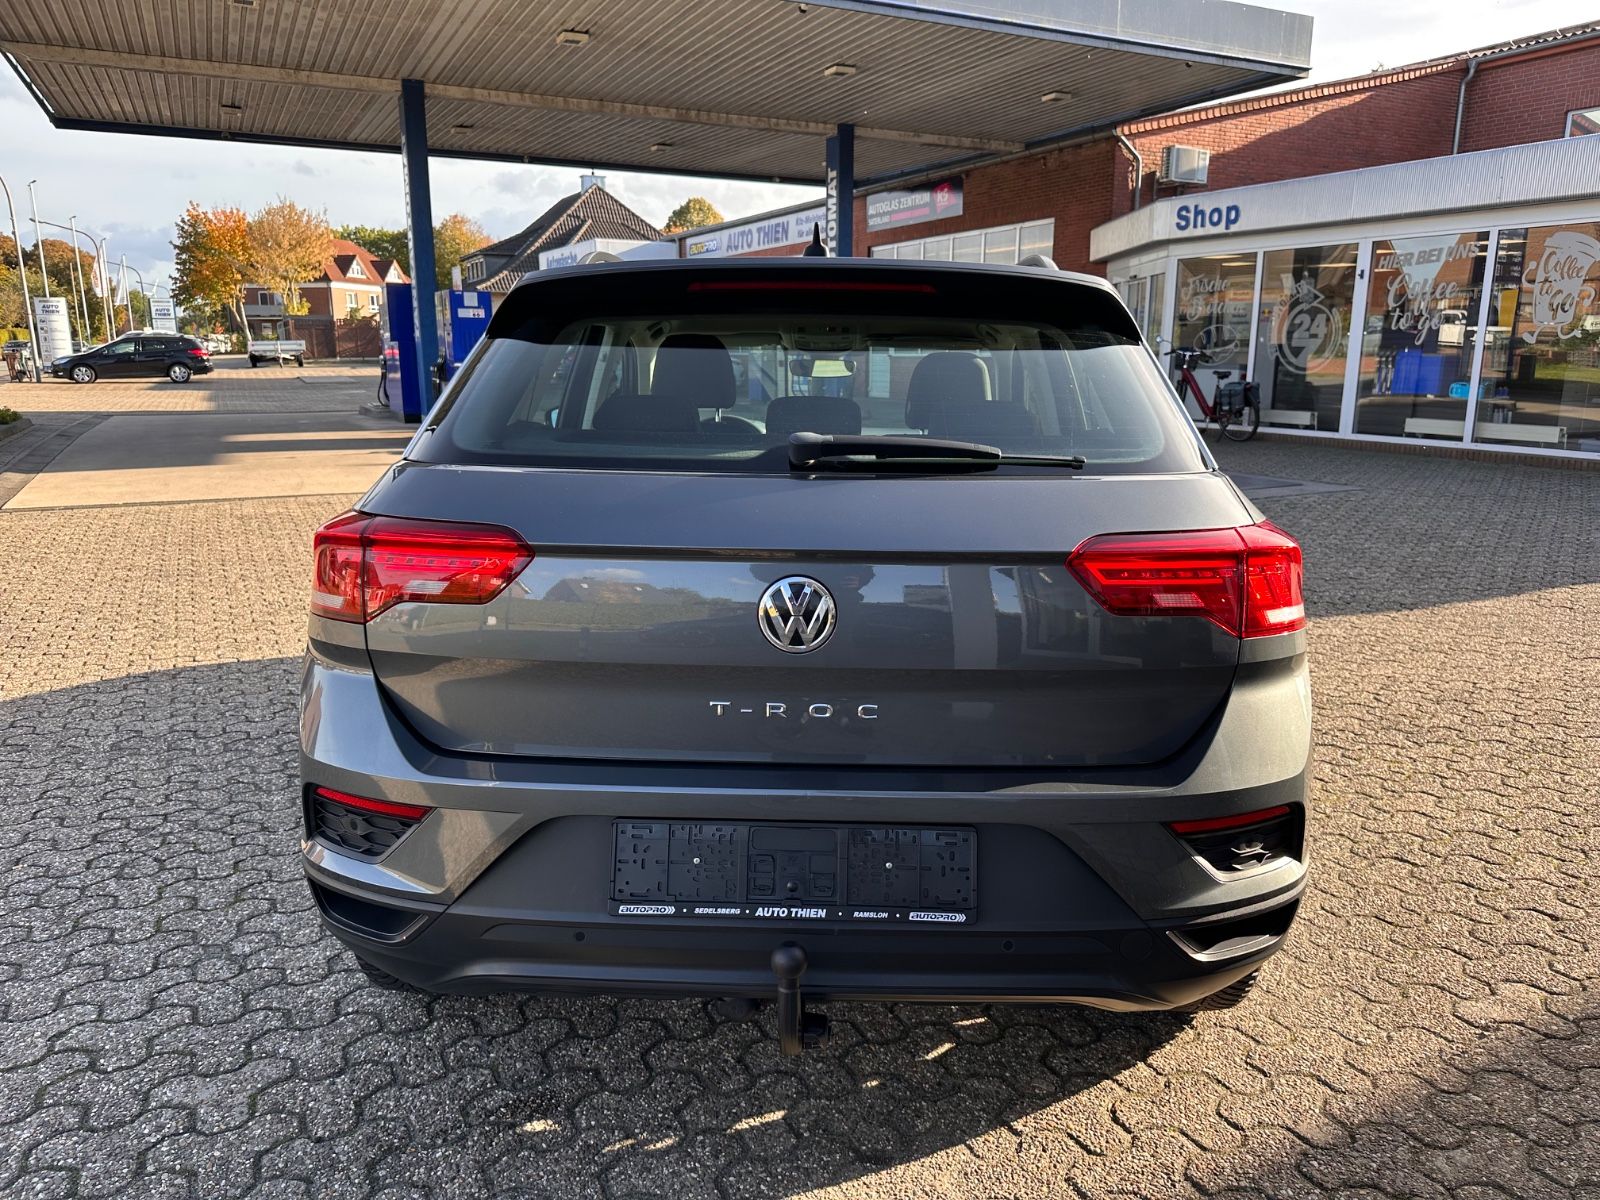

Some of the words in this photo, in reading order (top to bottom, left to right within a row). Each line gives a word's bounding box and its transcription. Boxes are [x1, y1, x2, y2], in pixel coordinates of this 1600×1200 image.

[827, 167, 837, 257] TOMAT
[868, 199, 899, 216] AUTOGLAS
[900, 191, 931, 209] ZENTRUM
[1175, 204, 1241, 231] Shop
[726, 229, 754, 253] AUTO
[757, 221, 790, 247] THIEN
[1378, 252, 1415, 270] HIER
[1415, 247, 1444, 266] BEI
[1446, 242, 1480, 260] UNS
[1543, 251, 1585, 281] Coffee
[1387, 273, 1461, 316] Coffee
[1292, 313, 1328, 339] 24
[1390, 308, 1414, 330] to
[1415, 311, 1446, 346] go
[694, 907, 741, 915] SEDELSBERG
[755, 907, 788, 917] AUTO
[790, 908, 826, 918] THIEN
[853, 911, 889, 919] RAMSLOH
